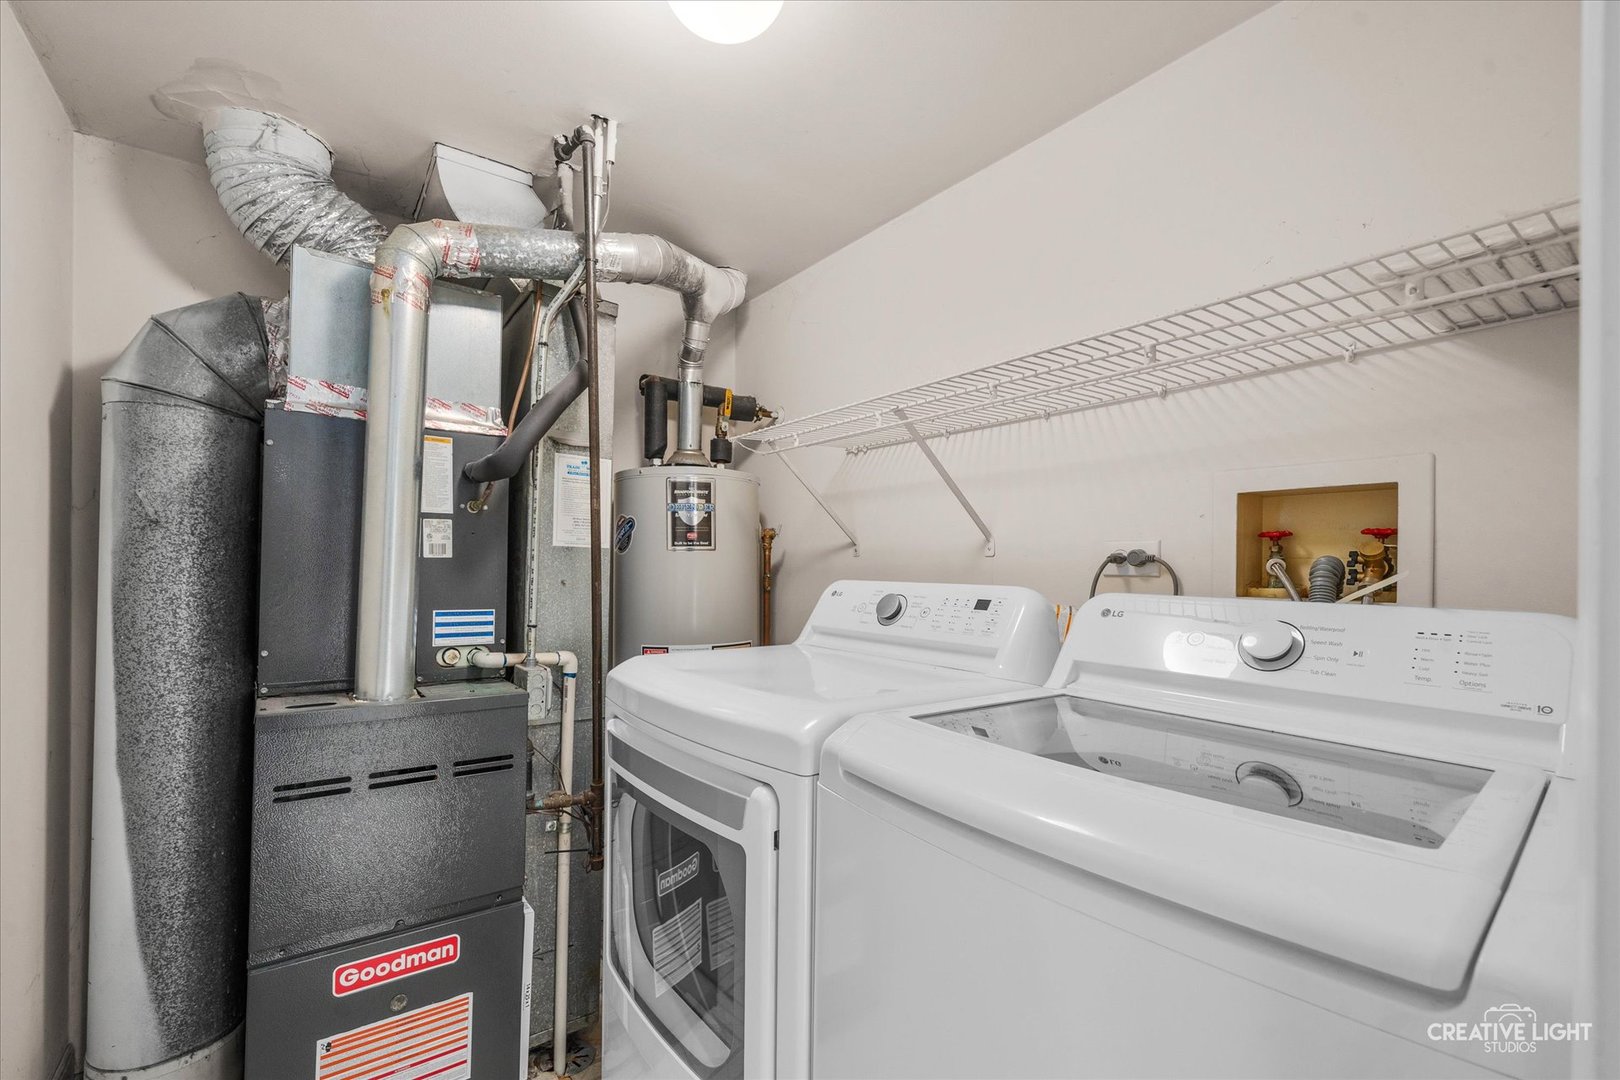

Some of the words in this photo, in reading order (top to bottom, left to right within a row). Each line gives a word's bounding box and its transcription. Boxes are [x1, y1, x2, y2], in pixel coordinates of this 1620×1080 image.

[667, 503, 715, 512] DEFENDER
[1459, 679, 1487, 688] Options
[338, 942, 455, 988] Goodman
